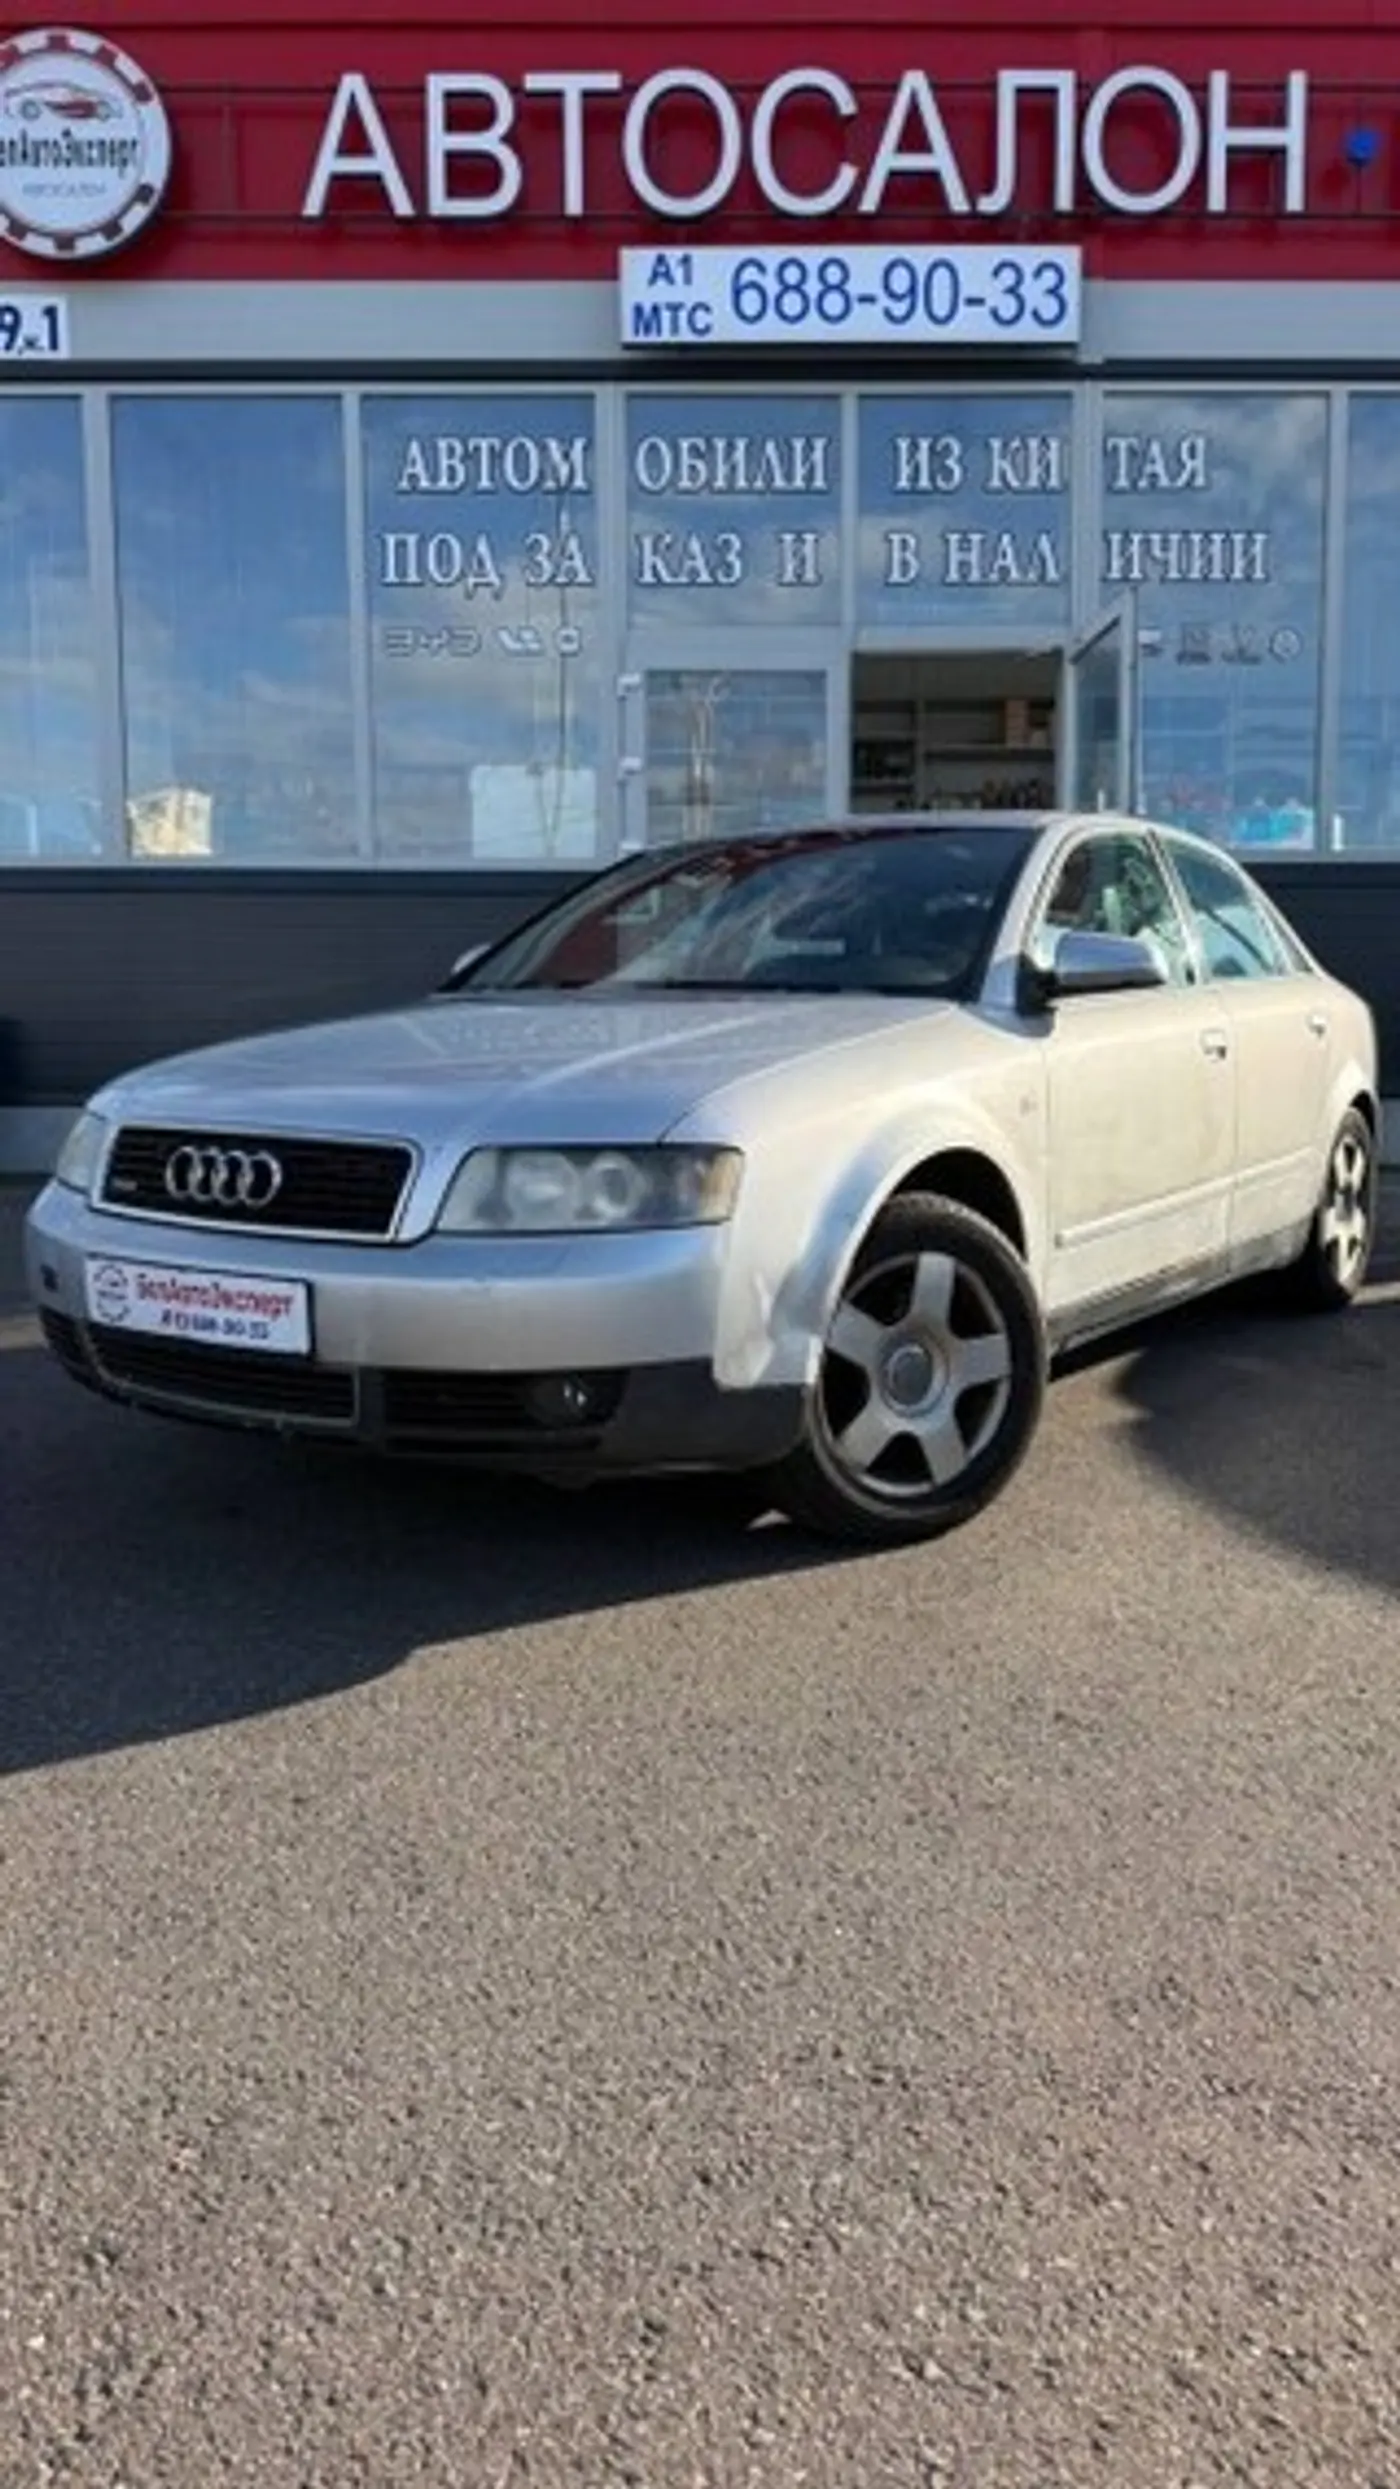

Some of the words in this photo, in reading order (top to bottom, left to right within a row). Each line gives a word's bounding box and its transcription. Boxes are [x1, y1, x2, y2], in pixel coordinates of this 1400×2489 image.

[302, 66, 1307, 217] АВТОСАЛОН
[632, 303, 713, 336] МТС
[730, 257, 1068, 328] 688-90-33
[895, 436, 963, 490] ИЗ
[382, 532, 502, 600] ПОД
[778, 532, 822, 585] И
[886, 532, 919, 585] В
